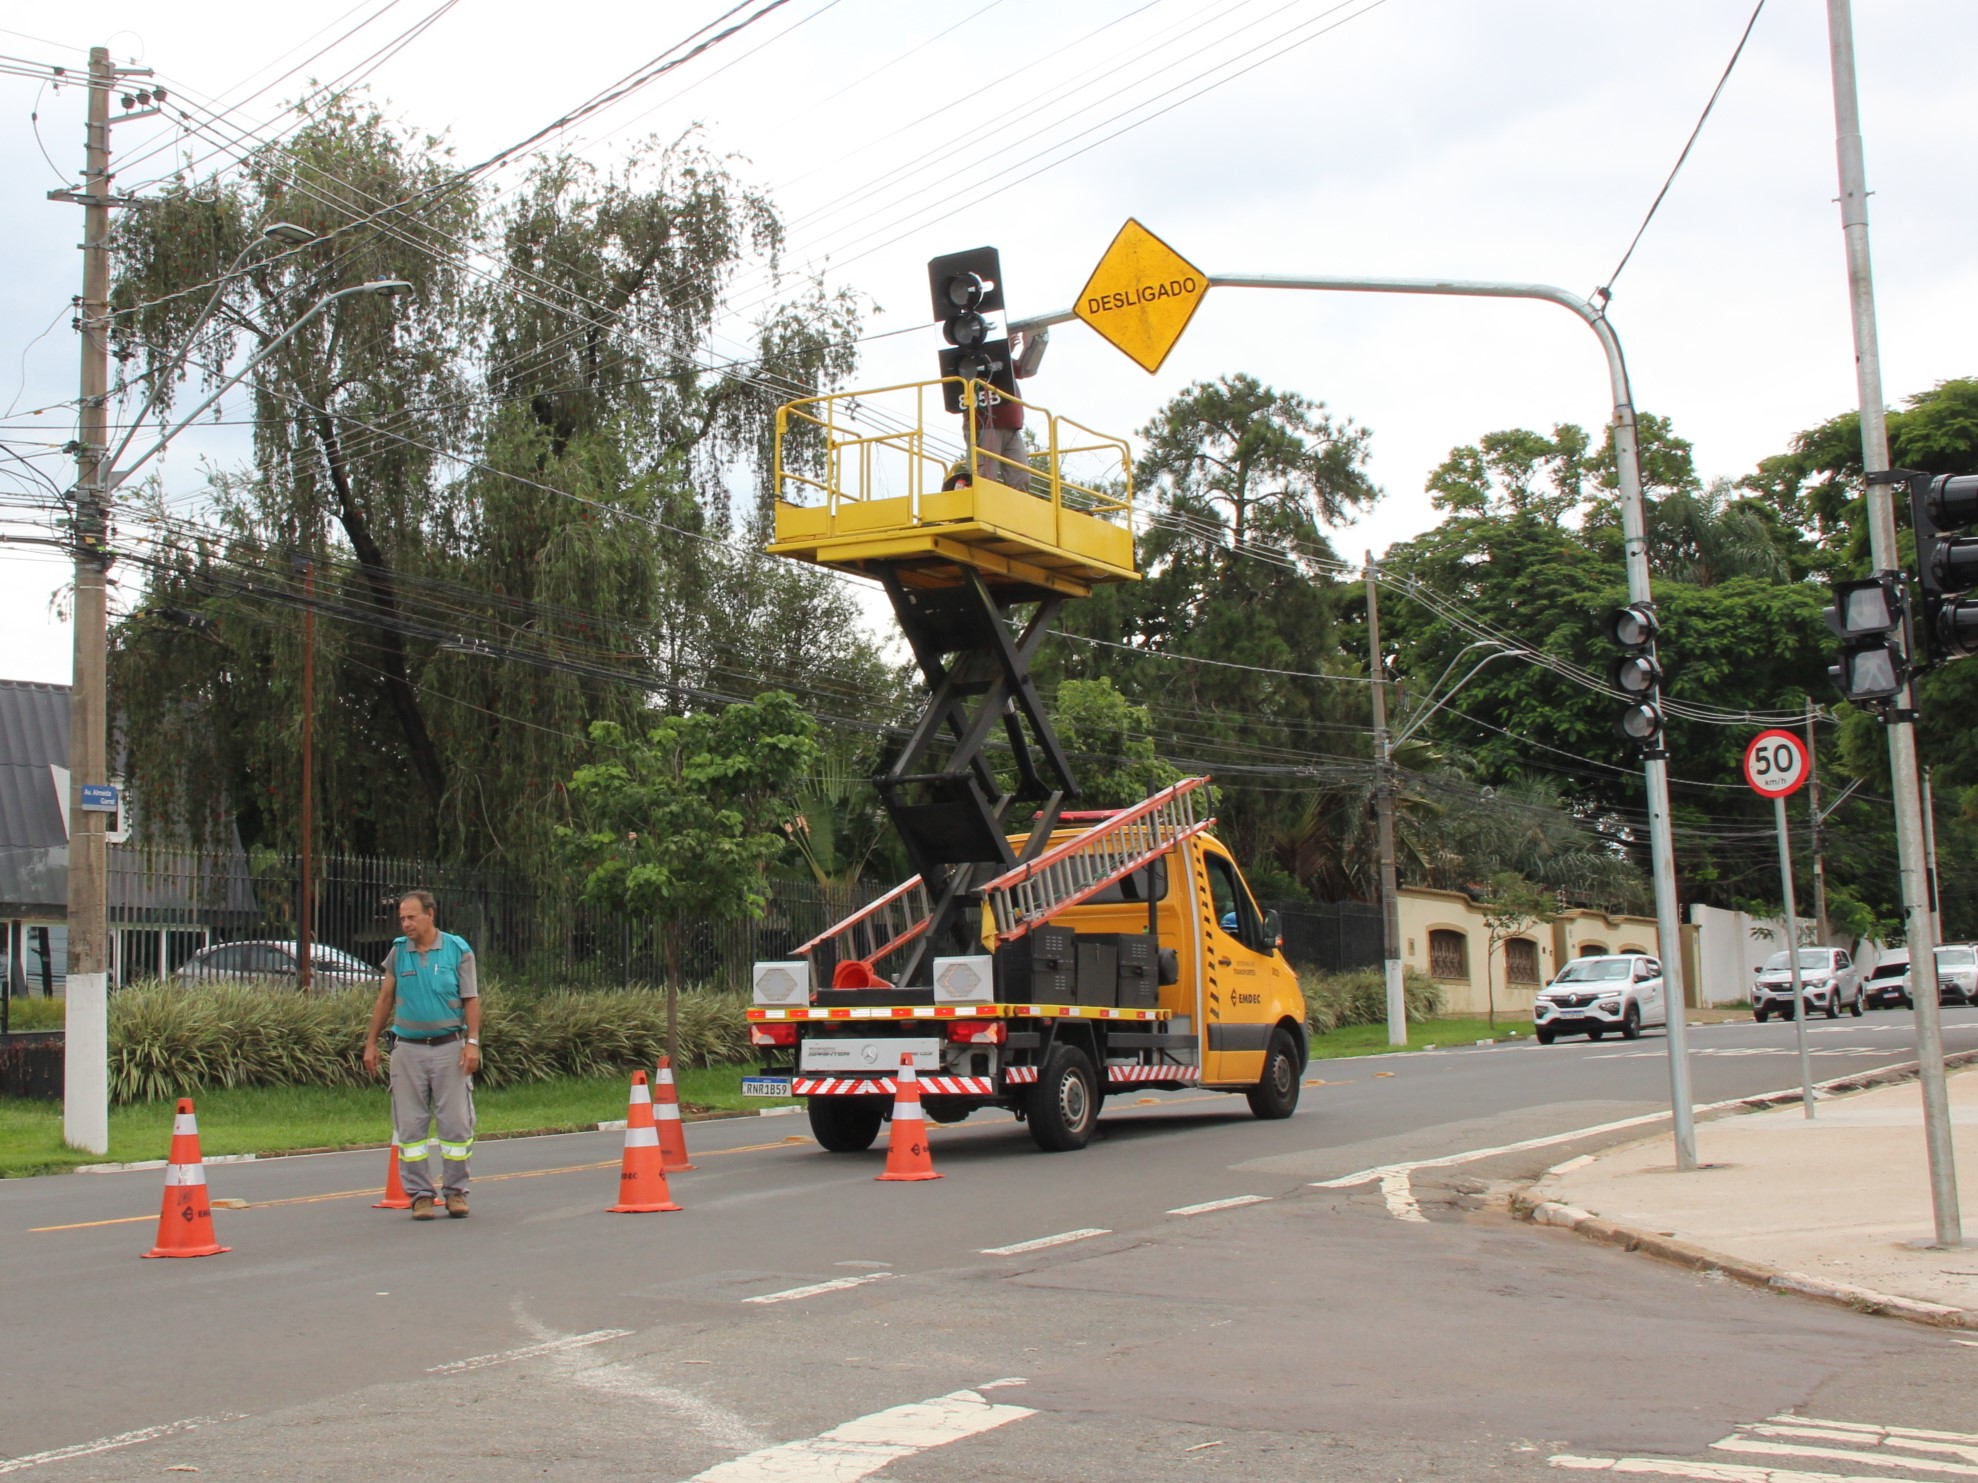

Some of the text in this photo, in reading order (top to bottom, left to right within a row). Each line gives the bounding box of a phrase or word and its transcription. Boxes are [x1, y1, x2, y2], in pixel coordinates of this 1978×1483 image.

[1088, 277, 1196, 314] DESLIGADO
[1755, 744, 1793, 775] 50
[1765, 777, 1787, 786] km/h
[93, 788, 112, 797] Almeida
[1239, 993, 1261, 1004] EMDEC
[747, 1083, 787, 1095] RNR1B59
